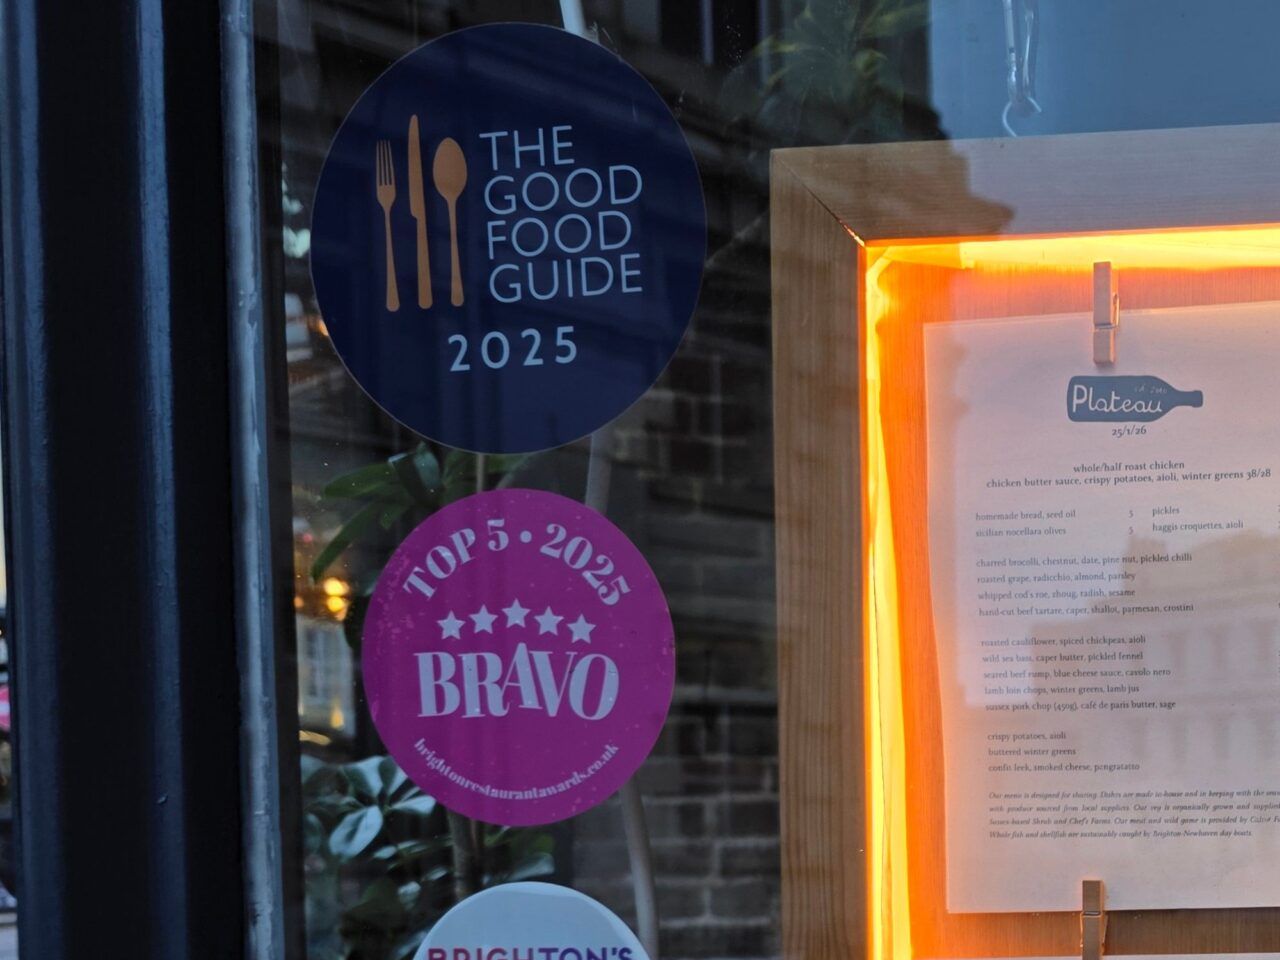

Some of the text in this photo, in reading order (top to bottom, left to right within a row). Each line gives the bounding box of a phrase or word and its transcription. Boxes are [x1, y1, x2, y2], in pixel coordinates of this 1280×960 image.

[480, 126, 574, 170] THE
[484, 165, 643, 215] GOOD
[487, 210, 632, 260] FOOD
[488, 254, 643, 303] GUIDE
[448, 326, 577, 372] 2025
[1072, 384, 1162, 413] Plateau
[986, 478, 1021, 487] chicken
[1024, 478, 1051, 486] butter
[1084, 476, 1110, 486] crispy
[1114, 475, 1153, 485] potatoes,
[1156, 472, 1178, 481] aioli,
[1214, 472, 1243, 481] greens
[1246, 468, 1270, 480] 38/28
[1073, 462, 1121, 472] whole/half
[1149, 460, 1184, 469] chicken
[1152, 505, 1179, 517] pickles
[402, 519, 630, 606] TOP 5 2025
[414, 642, 619, 721] BRAVO
